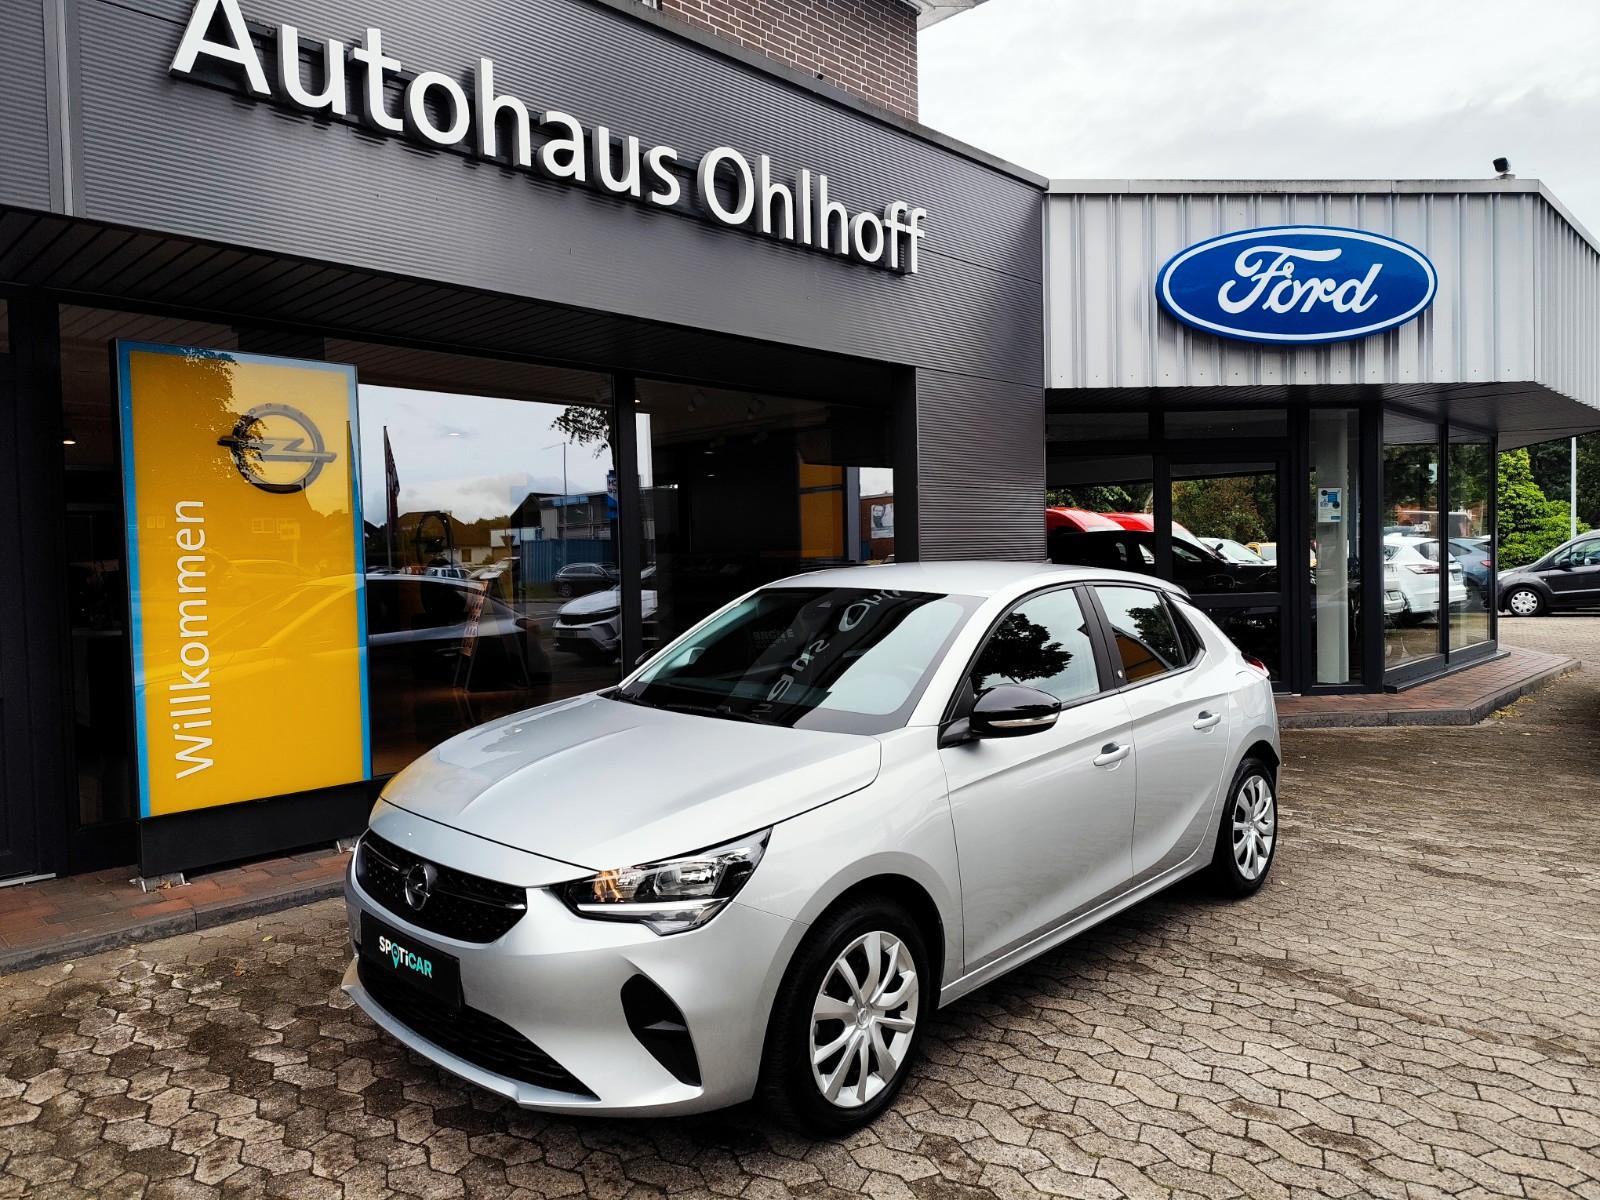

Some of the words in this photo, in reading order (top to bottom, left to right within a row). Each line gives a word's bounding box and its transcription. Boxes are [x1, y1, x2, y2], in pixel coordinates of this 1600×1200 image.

[169, 0, 681, 206] Autohaus
[699, 146, 927, 273] Ohlhoff
[1217, 245, 1384, 314] Ford
[169, 500, 214, 780] Willkommen
